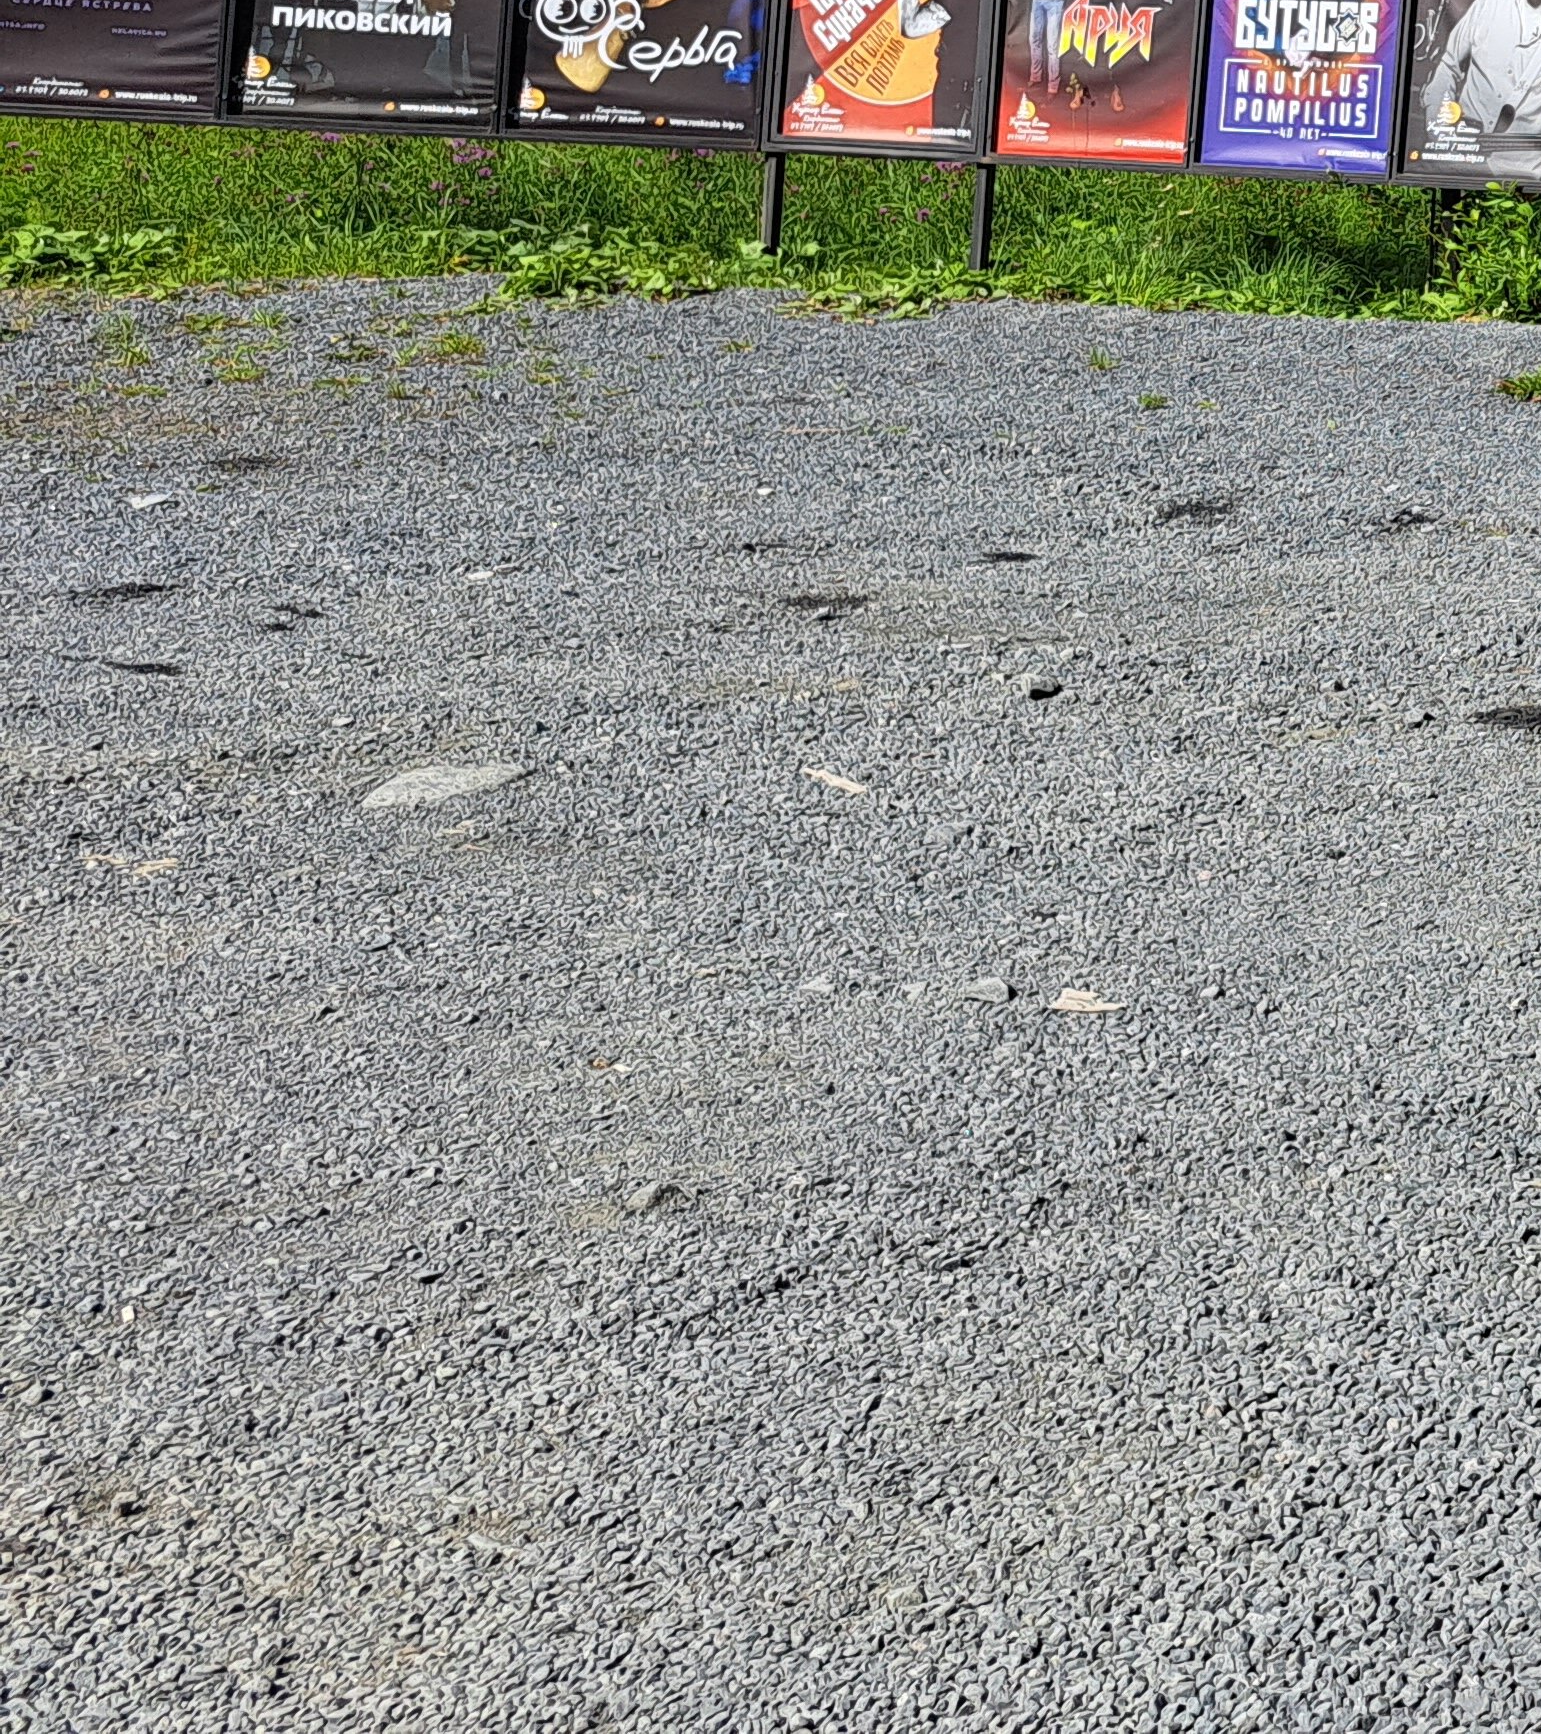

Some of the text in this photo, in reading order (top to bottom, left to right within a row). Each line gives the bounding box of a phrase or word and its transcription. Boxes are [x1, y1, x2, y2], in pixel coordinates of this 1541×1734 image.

[271, 5, 453, 37] ПИКОВСКИЙ
[1236, 68, 1370, 99] NAUTILUS
[1234, 97, 1368, 128] POMPILIUS
